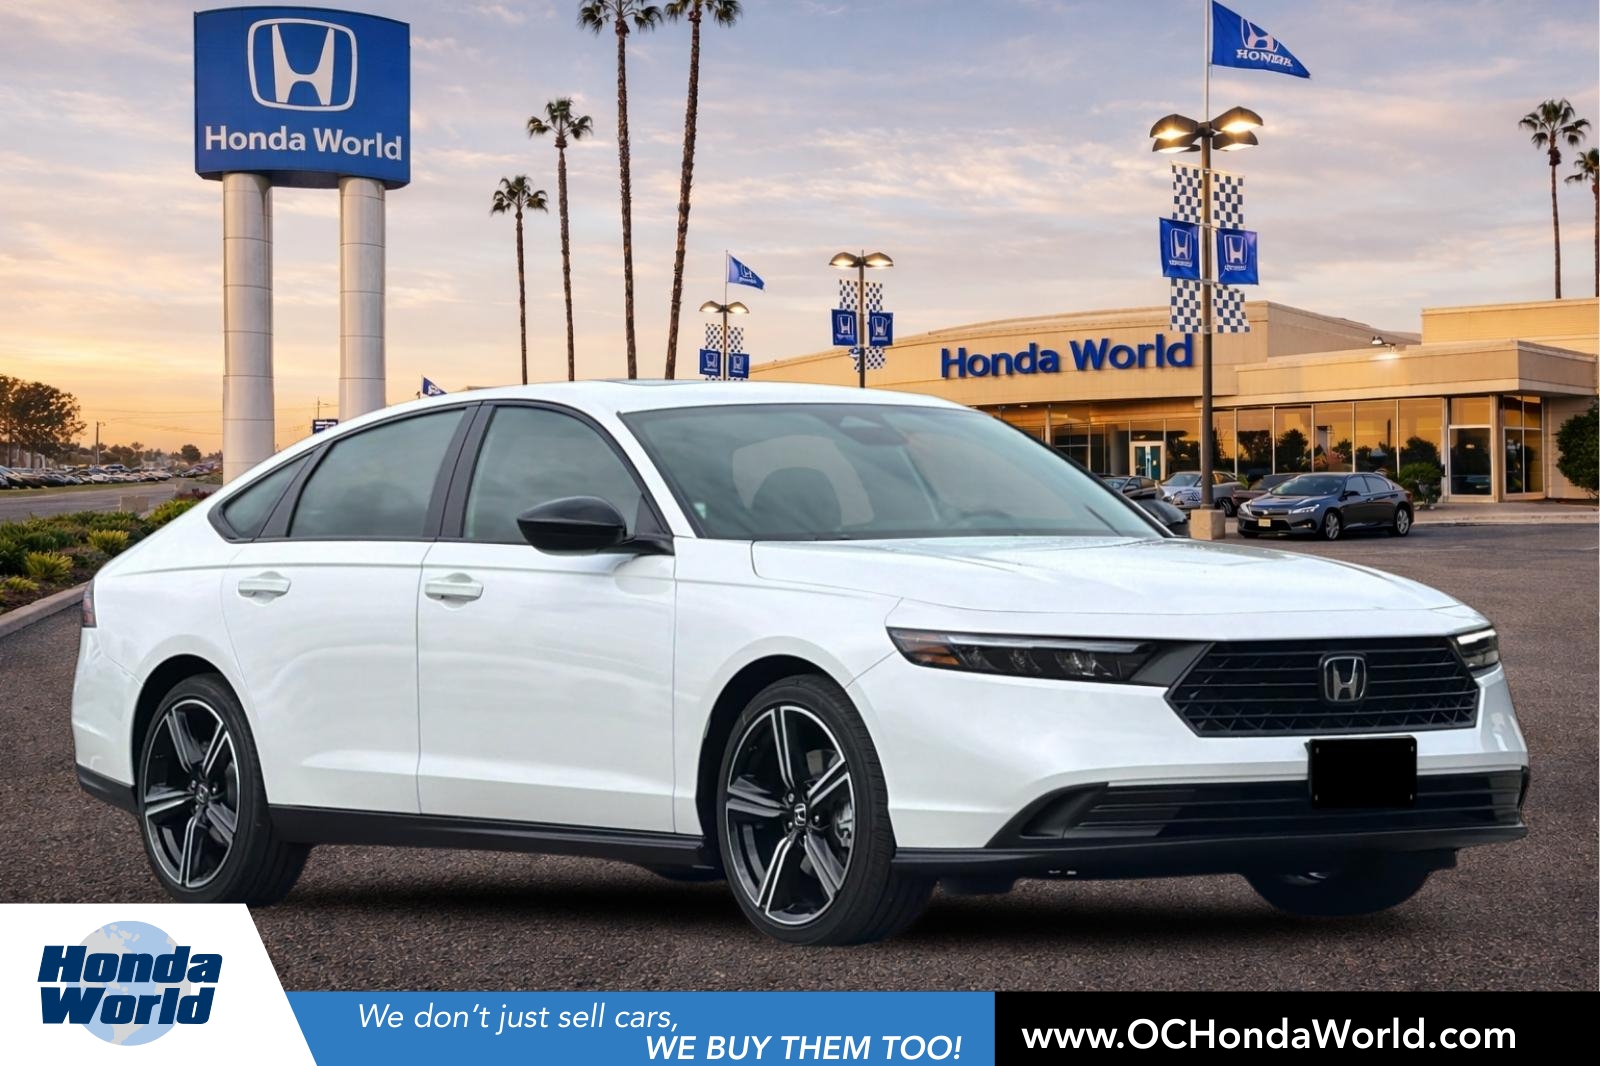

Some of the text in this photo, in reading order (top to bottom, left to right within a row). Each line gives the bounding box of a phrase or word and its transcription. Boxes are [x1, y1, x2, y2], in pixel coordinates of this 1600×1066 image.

[205, 125, 402, 161] Honda World
[941, 333, 1194, 377] Honda World
